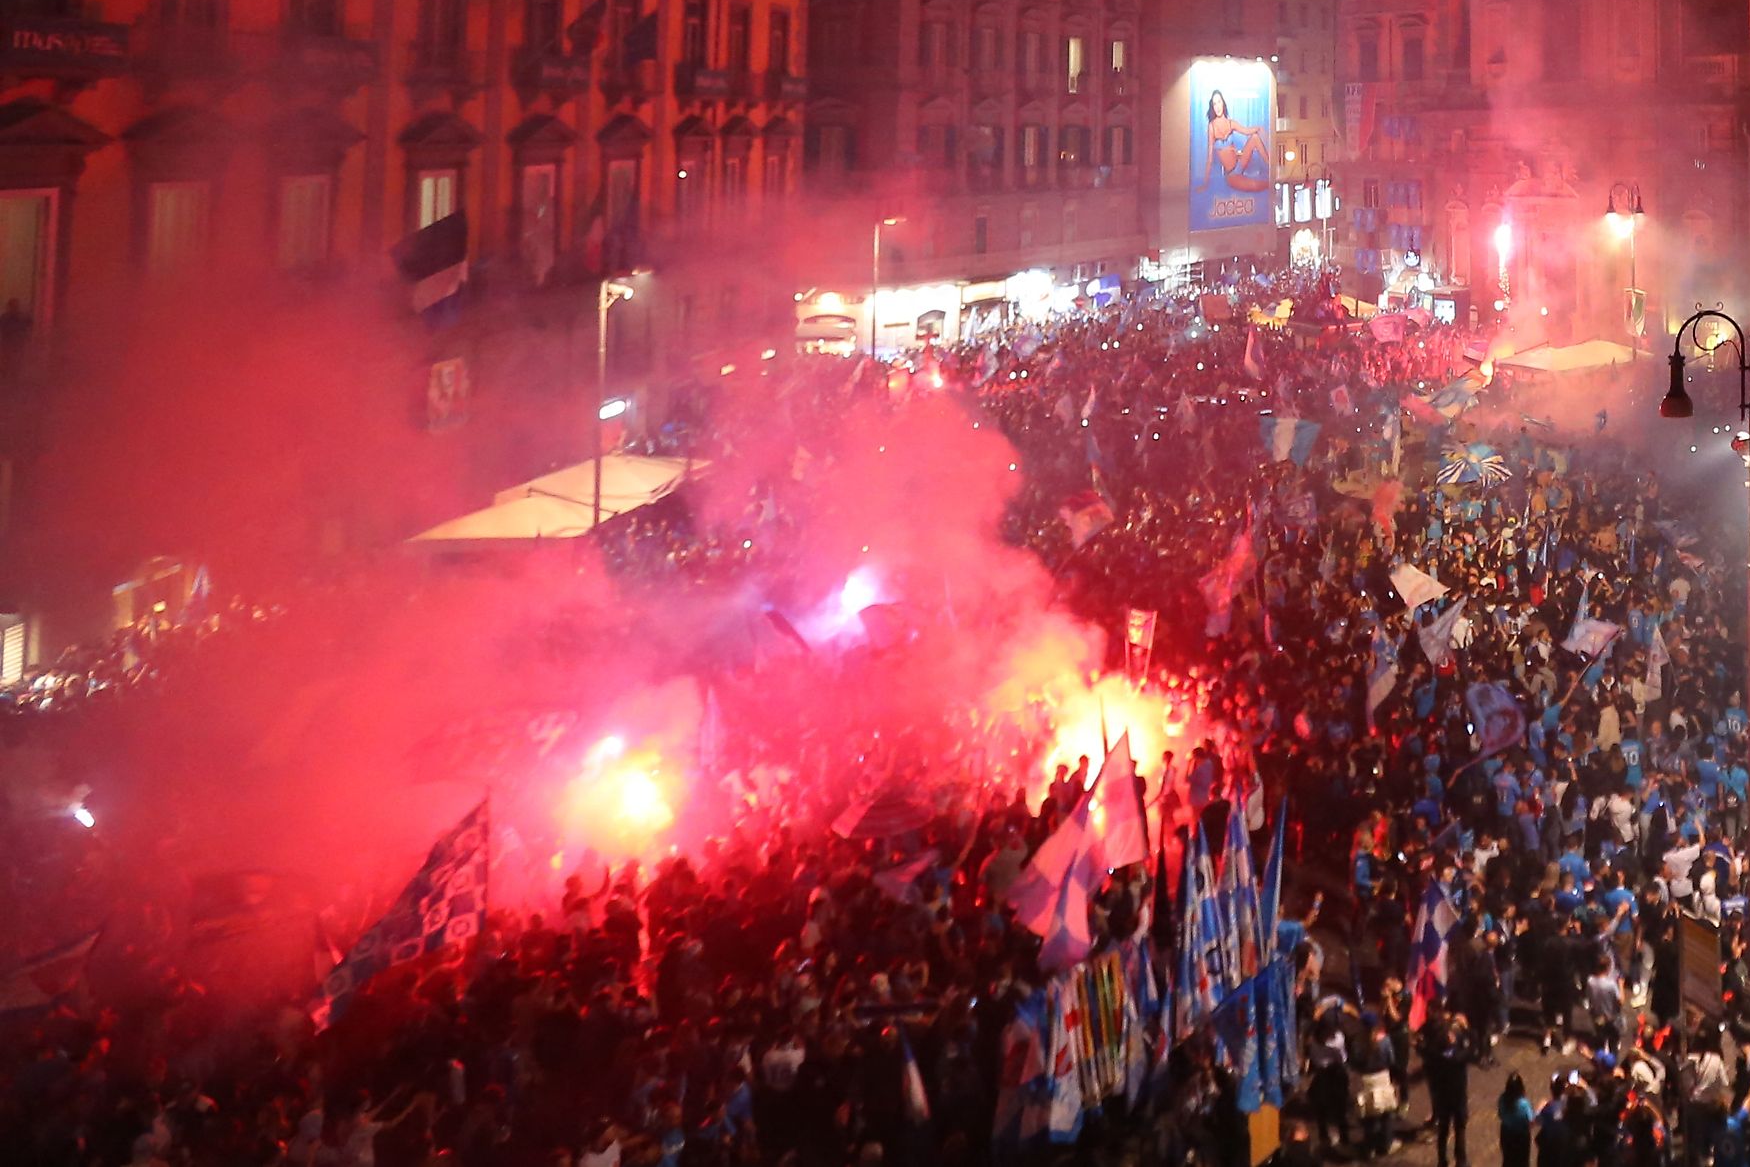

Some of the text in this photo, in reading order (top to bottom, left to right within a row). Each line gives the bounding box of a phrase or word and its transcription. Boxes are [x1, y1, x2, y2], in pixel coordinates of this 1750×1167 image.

[1209, 194, 1254, 219] Jadea
[1728, 718, 1741, 732] 10
[1622, 751, 1640, 766] 10
